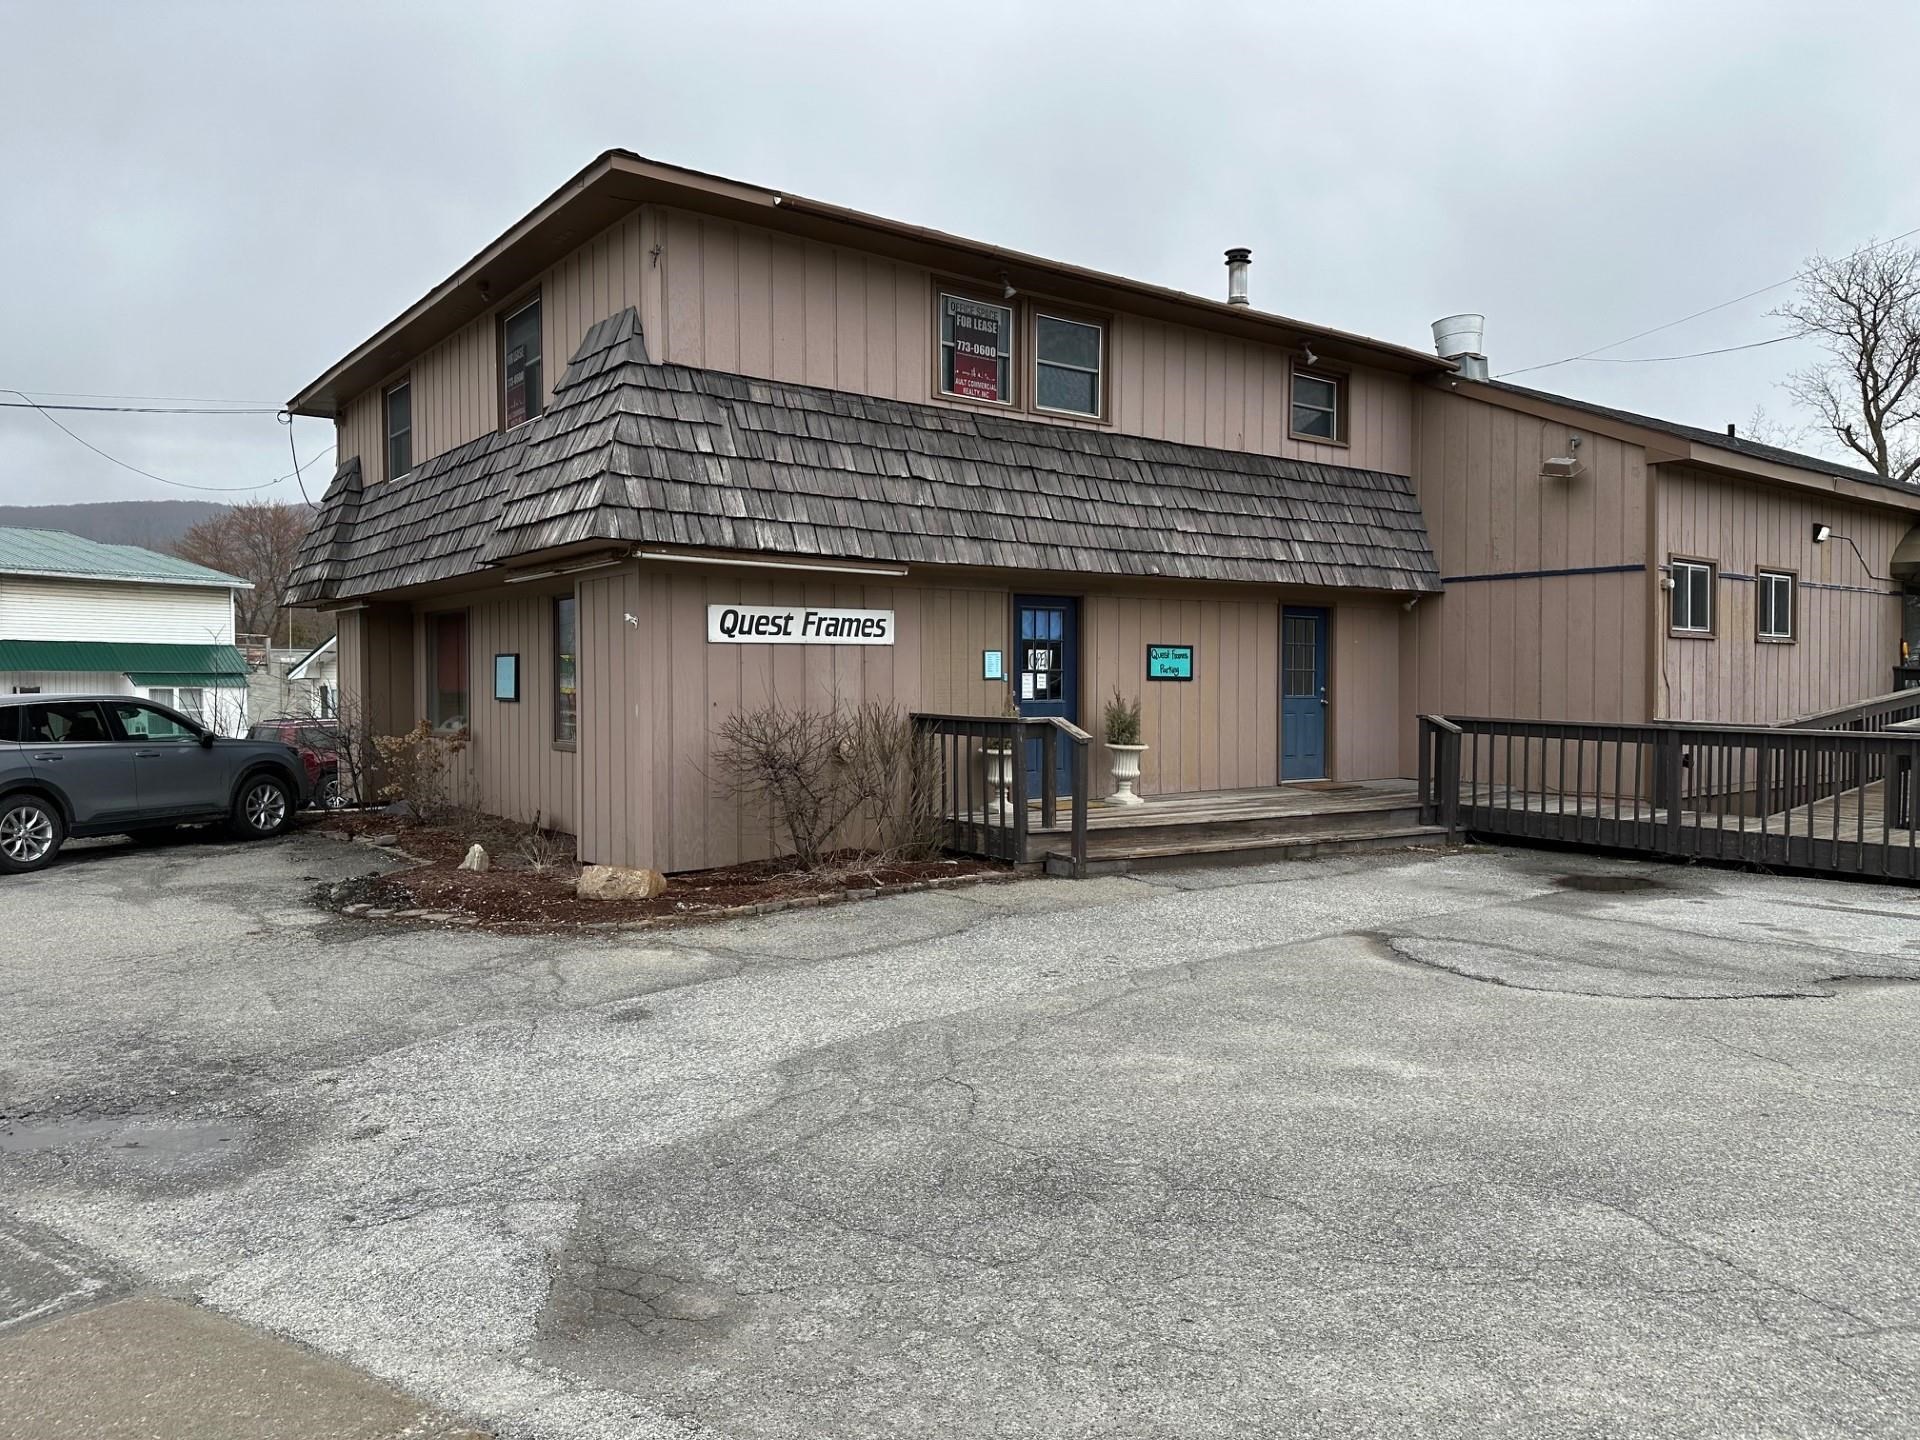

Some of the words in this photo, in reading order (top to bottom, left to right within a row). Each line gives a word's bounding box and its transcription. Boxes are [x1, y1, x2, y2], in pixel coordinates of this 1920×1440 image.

[956, 314, 972, 328] FOR
[974, 318, 998, 334] LEASE
[956, 340, 996, 357] 773-0600
[719, 609, 794, 638] Quest
[801, 611, 887, 638] Frames
[1151, 648, 1169, 660] Quest
